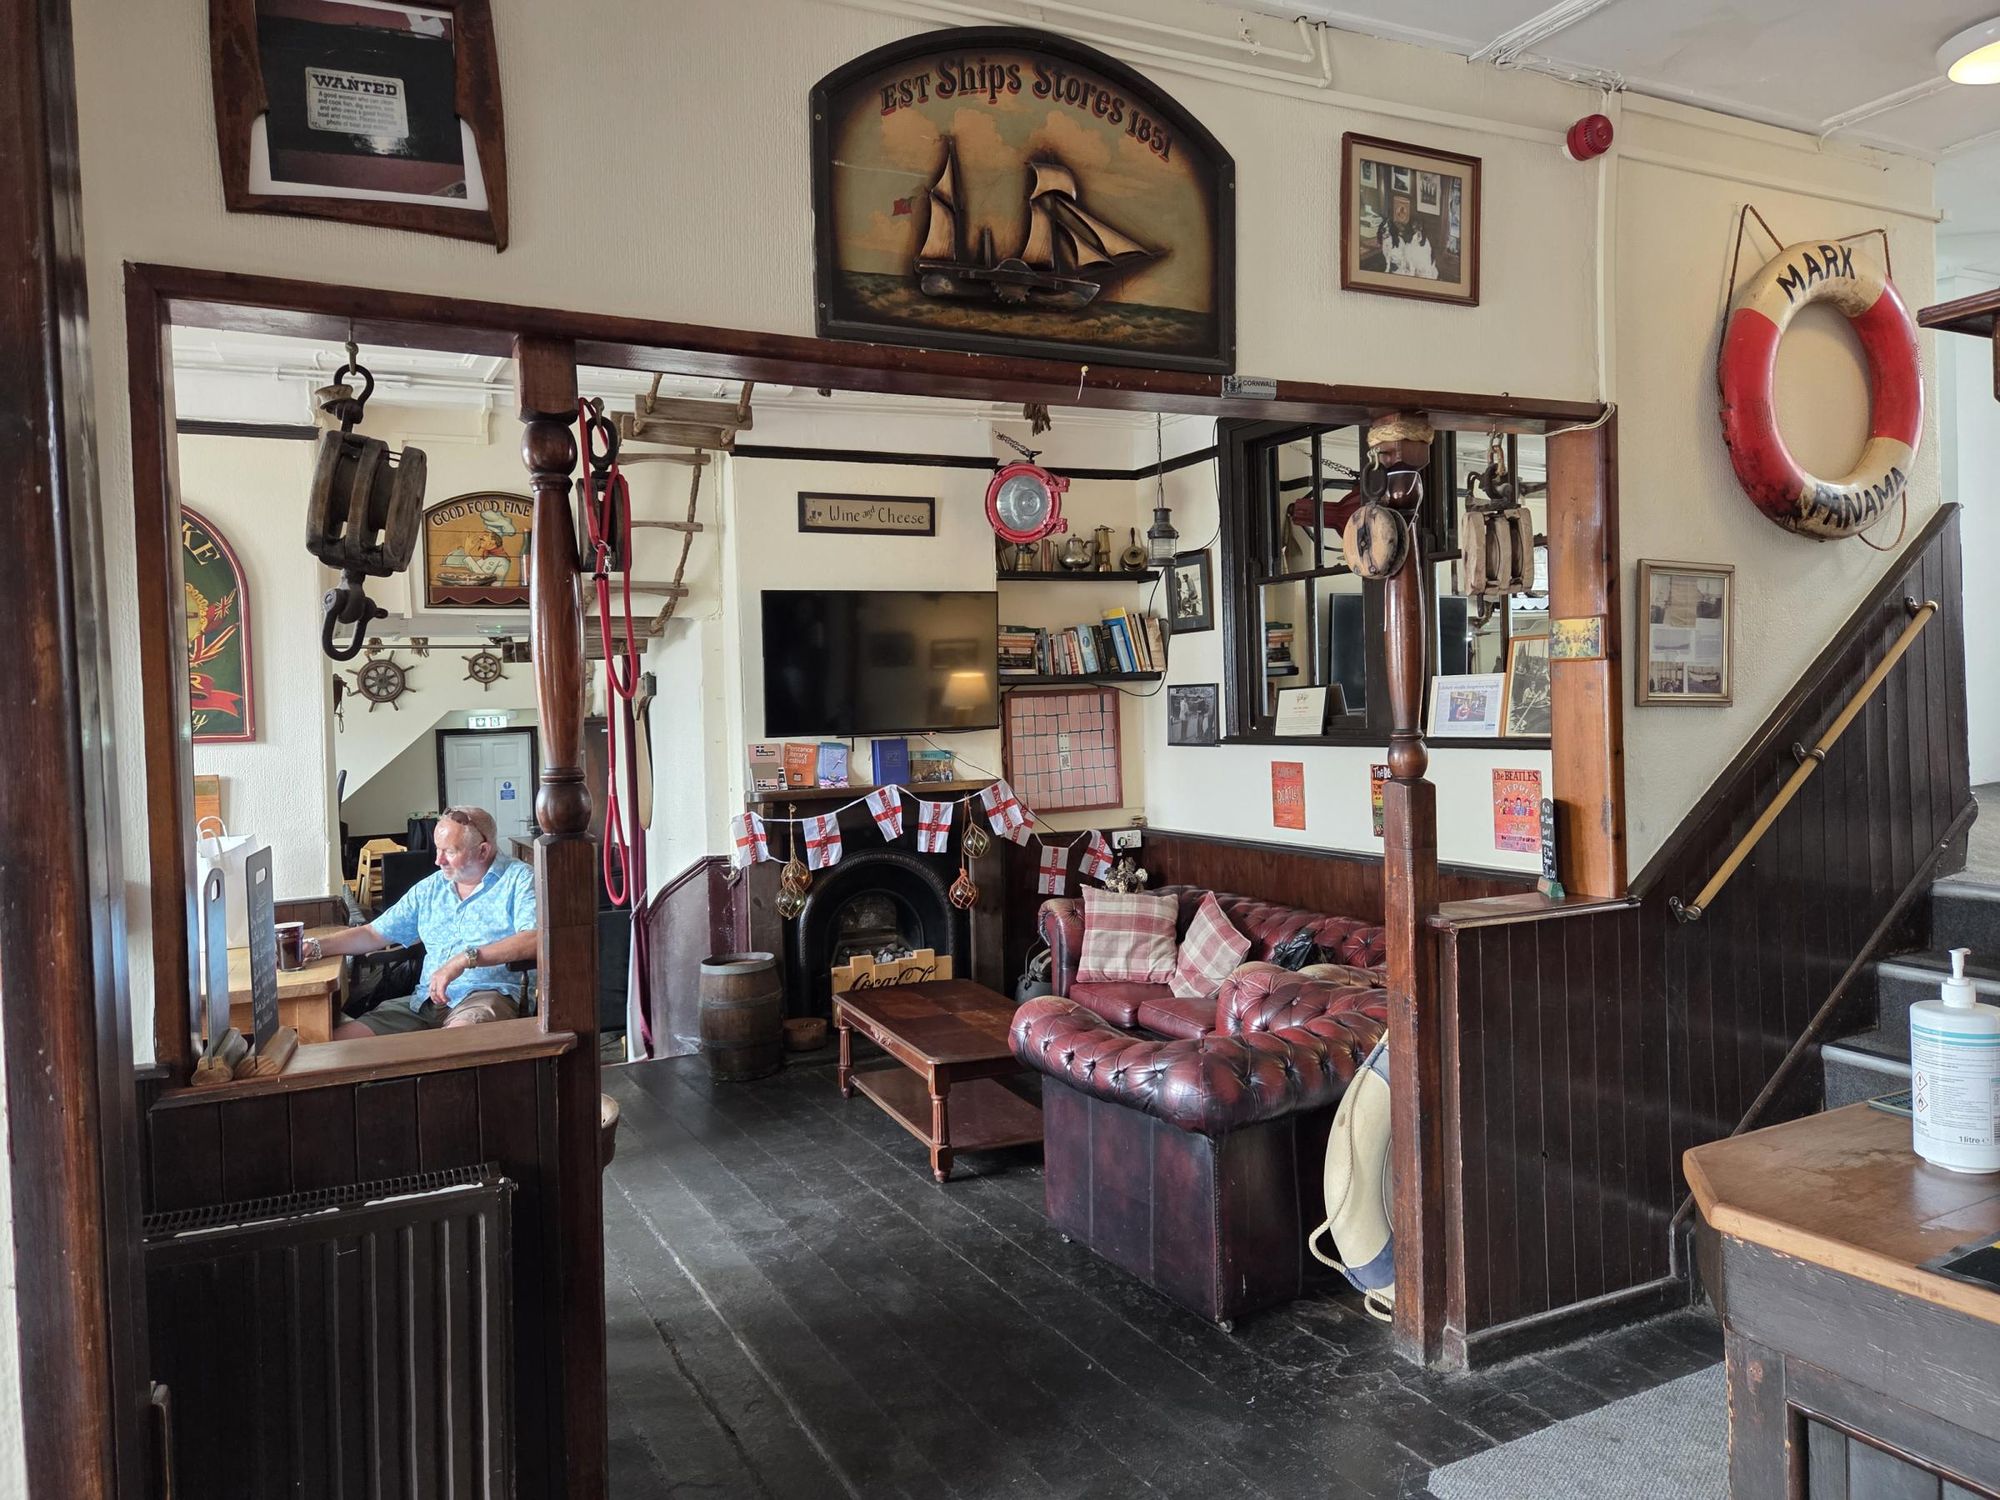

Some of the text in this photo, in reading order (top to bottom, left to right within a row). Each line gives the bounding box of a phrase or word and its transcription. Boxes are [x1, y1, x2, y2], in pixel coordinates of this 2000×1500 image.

[312, 74, 397, 95] WANTED
[880, 57, 1174, 162] EST Ships Stores 1851
[1776, 244, 1856, 304] MARK
[1242, 380, 1276, 388] CORNWALL
[432, 500, 532, 526] GOOD FOOD FINE
[829, 505, 925, 524] Wine and Cheese
[1808, 467, 1907, 528] PANAMA
[1505, 771, 1538, 782] BEATLES
[880, 793, 900, 838] ENGLAND
[930, 808, 941, 852] ENGLAND
[818, 820, 830, 867] ENGLAND
[1048, 850, 1058, 895] ENGLAND
